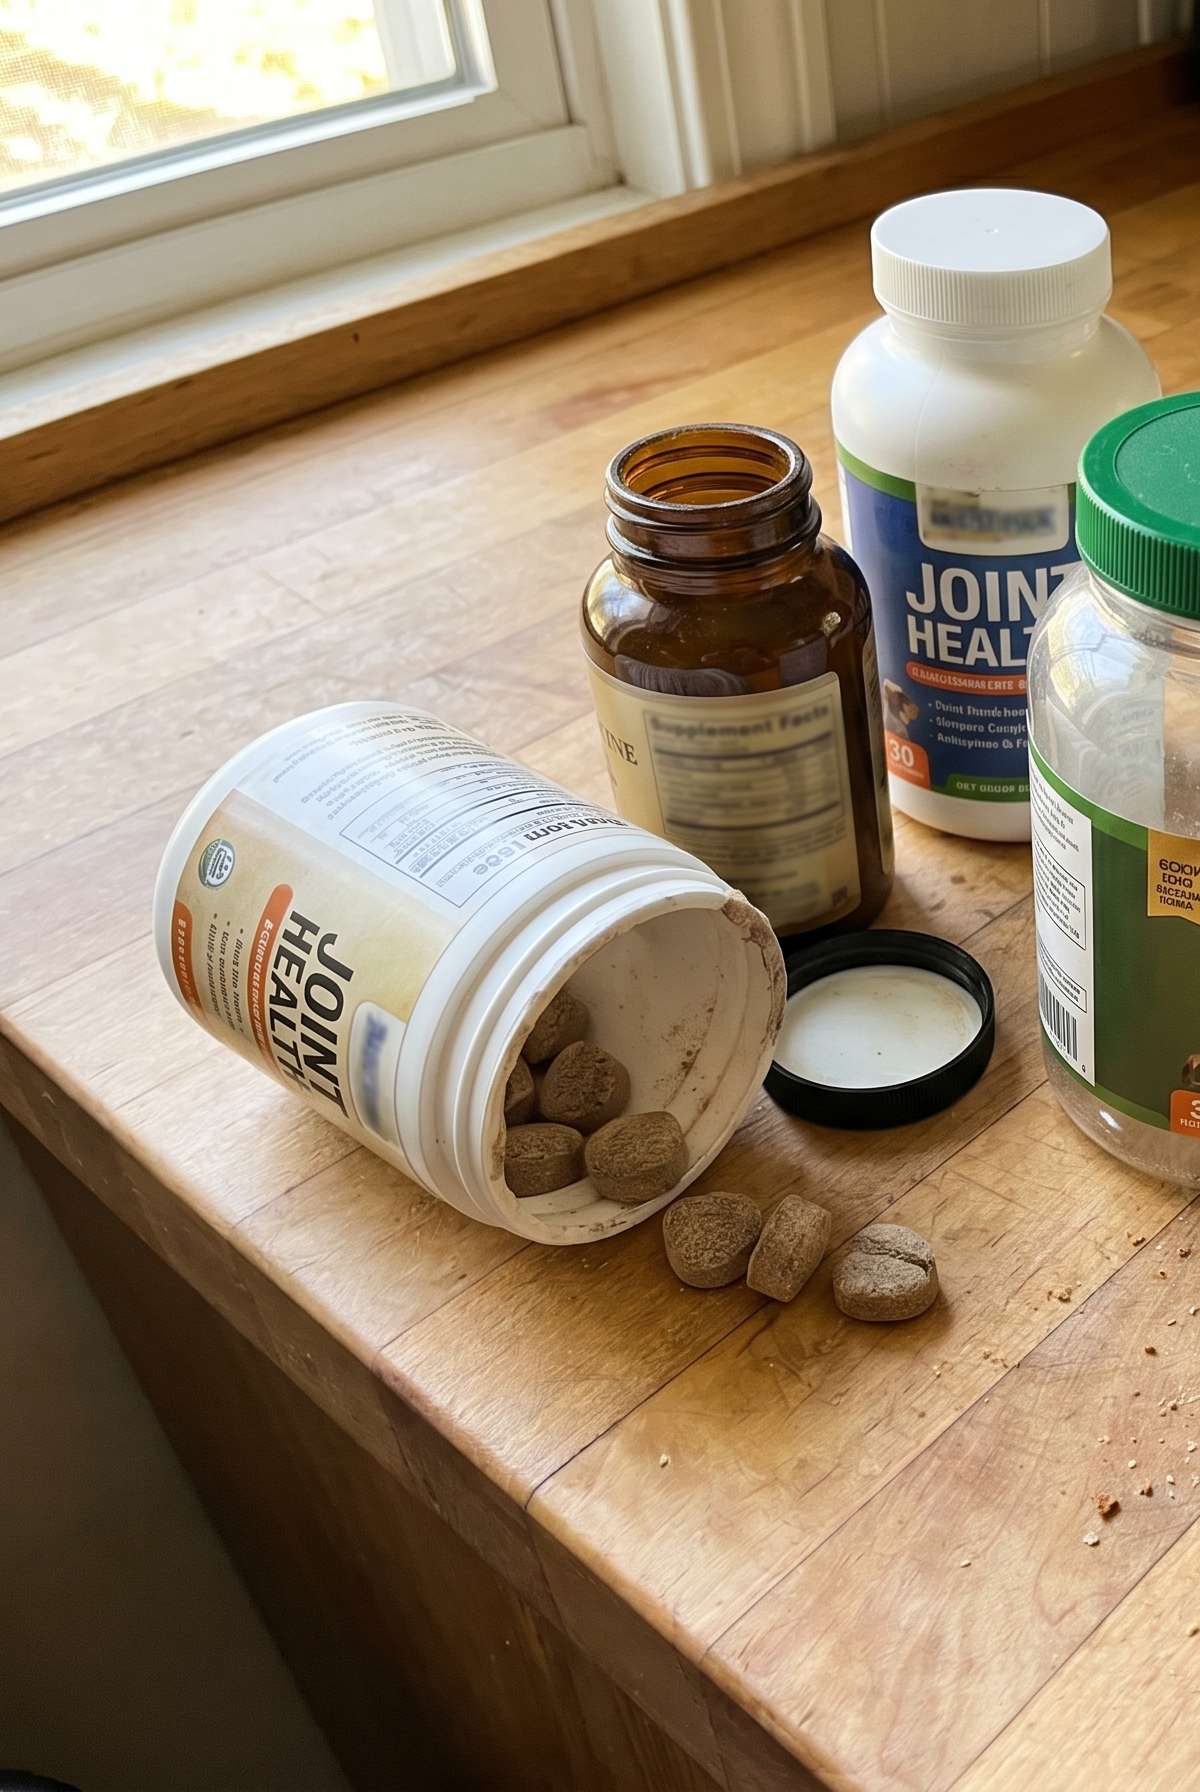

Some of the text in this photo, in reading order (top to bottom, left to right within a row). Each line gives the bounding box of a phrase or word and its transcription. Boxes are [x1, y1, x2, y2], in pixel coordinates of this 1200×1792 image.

[602, 727, 638, 766] INE
[889, 738, 915, 768] 30
[301, 932, 355, 1120] JOINT
